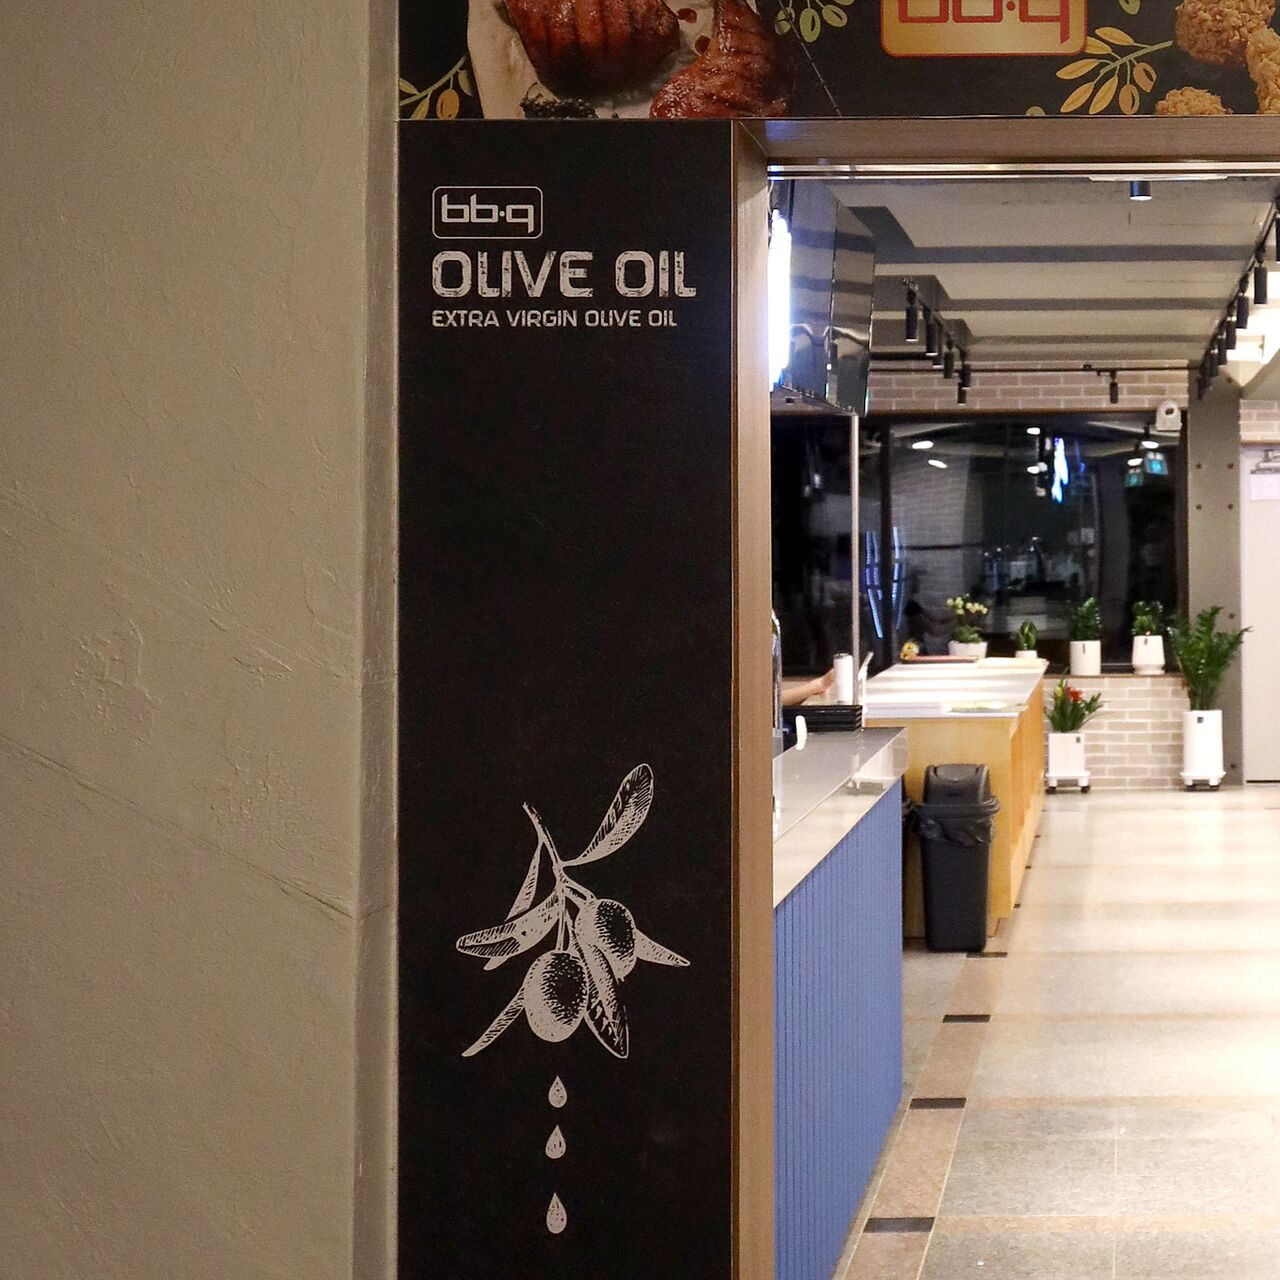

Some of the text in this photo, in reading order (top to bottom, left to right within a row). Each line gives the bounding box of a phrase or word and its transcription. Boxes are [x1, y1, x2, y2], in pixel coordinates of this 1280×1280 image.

[432, 250, 698, 298] OLIVE OIL
[432, 309, 678, 328] EXTRA VIRGIN OLIVE OIL
